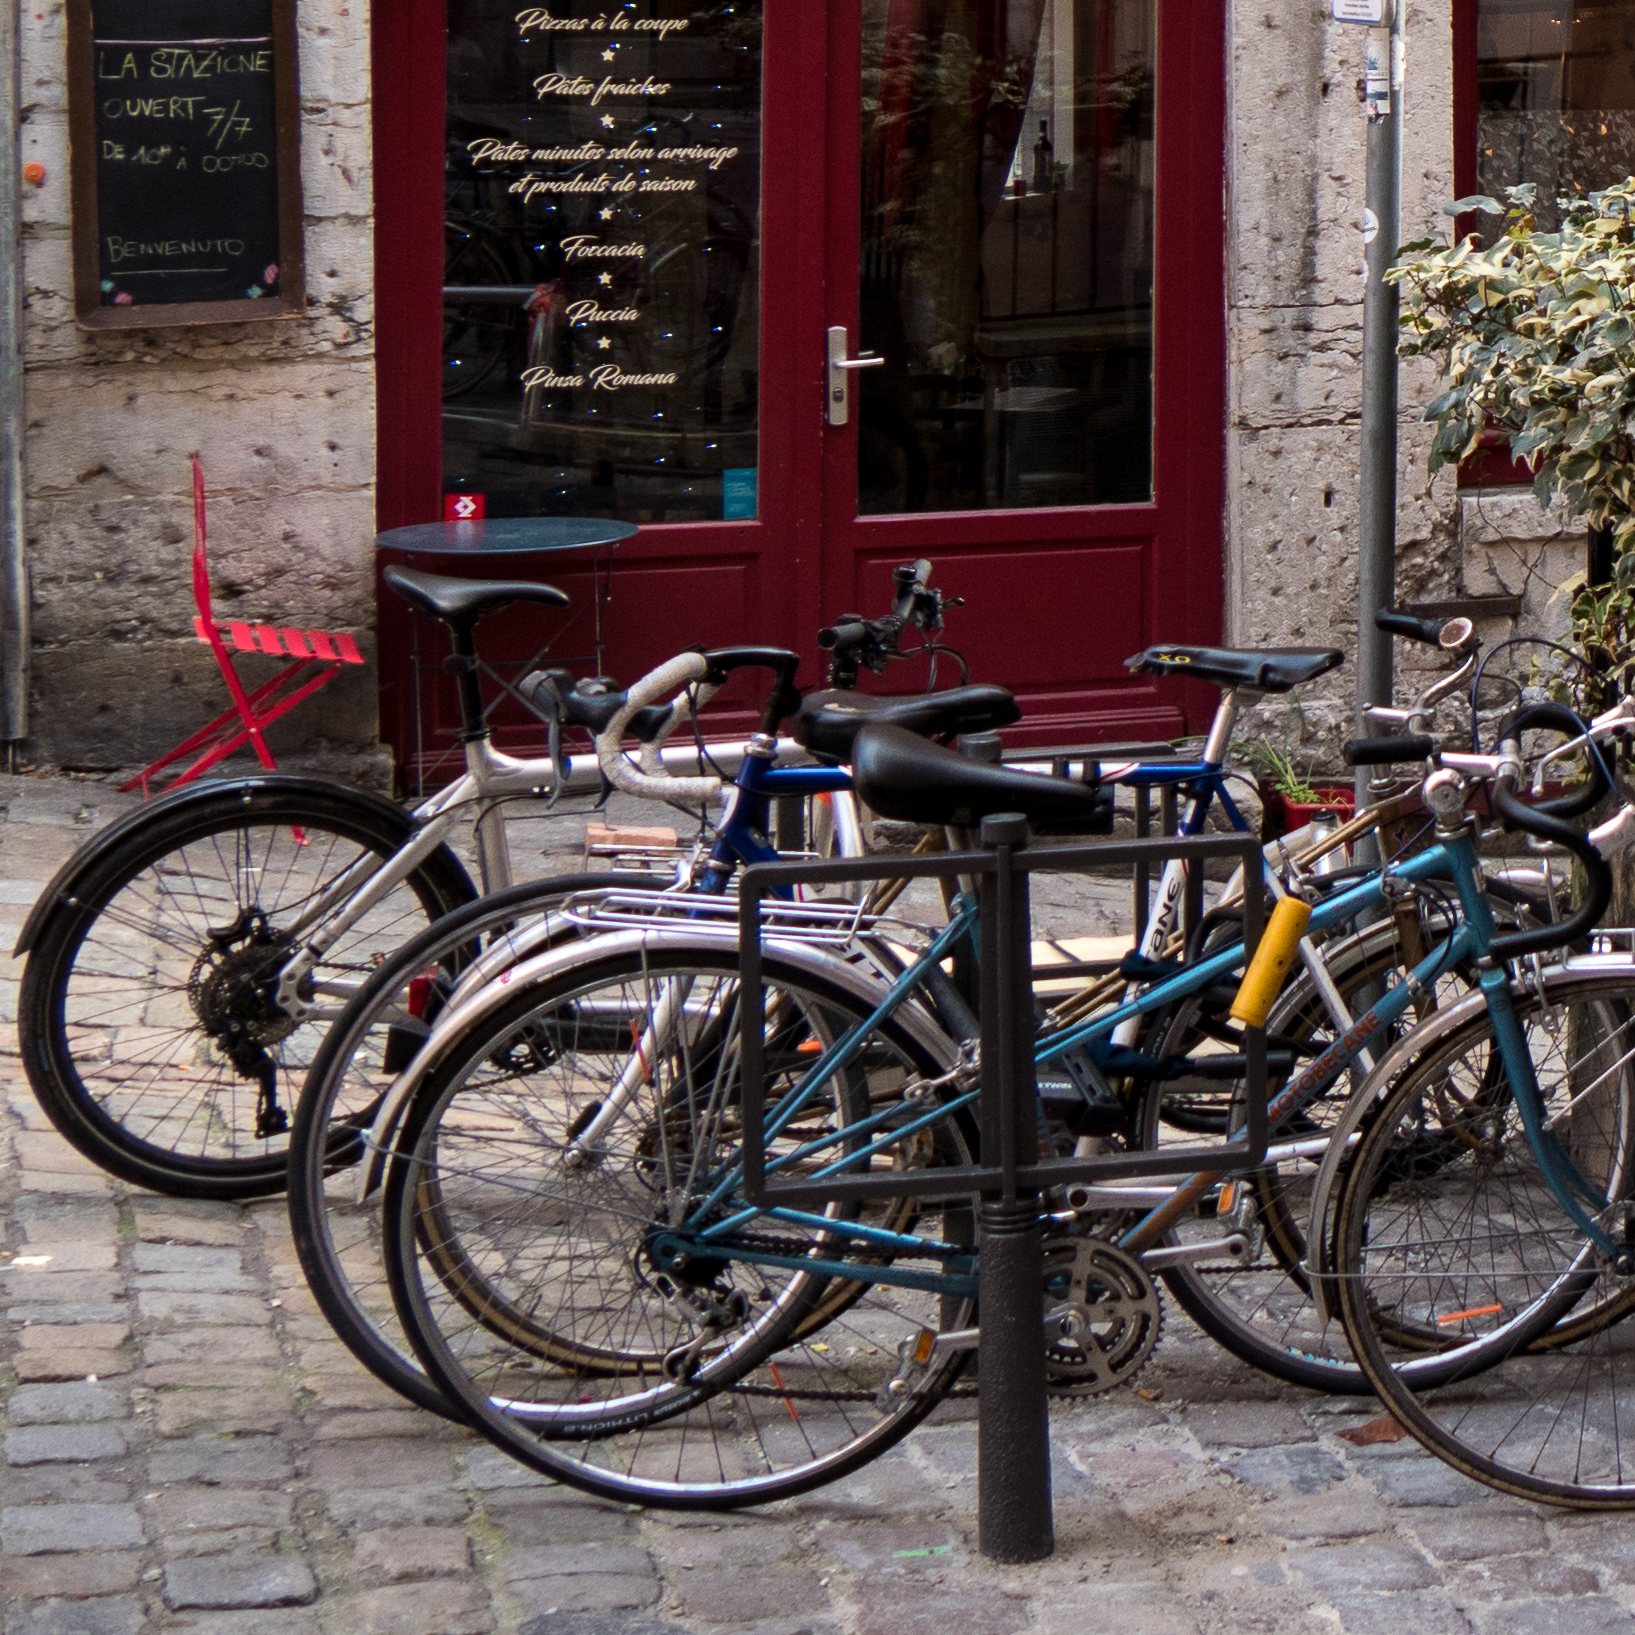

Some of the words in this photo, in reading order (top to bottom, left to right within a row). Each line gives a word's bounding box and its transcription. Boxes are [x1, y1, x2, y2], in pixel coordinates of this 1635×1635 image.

[514, 8, 588, 34] Pizzas
[589, 12, 608, 30] à
[609, 11, 630, 30] la
[633, 17, 689, 40] coupe
[99, 52, 137, 78] LA
[533, 72, 594, 100] Pâtes
[590, 75, 671, 106] fraîches
[103, 96, 206, 120] OUVERT
[202, 99, 252, 150] 7/7
[102, 140, 125, 159] DE
[467, 137, 530, 165] Pâtes
[533, 142, 605, 160] minutes
[607, 143, 656, 160] selon
[658, 145, 739, 170] arrivage
[508, 174, 530, 194] et
[524, 173, 611, 204] produits
[612, 173, 637, 192] de
[639, 177, 697, 192] saison
[106, 235, 245, 262] BENVENUTO
[559, 235, 648, 262] Foccacia
[565, 300, 641, 327] Puccia
[520, 365, 586, 392] Pinsa
[588, 365, 679, 392] Romana
